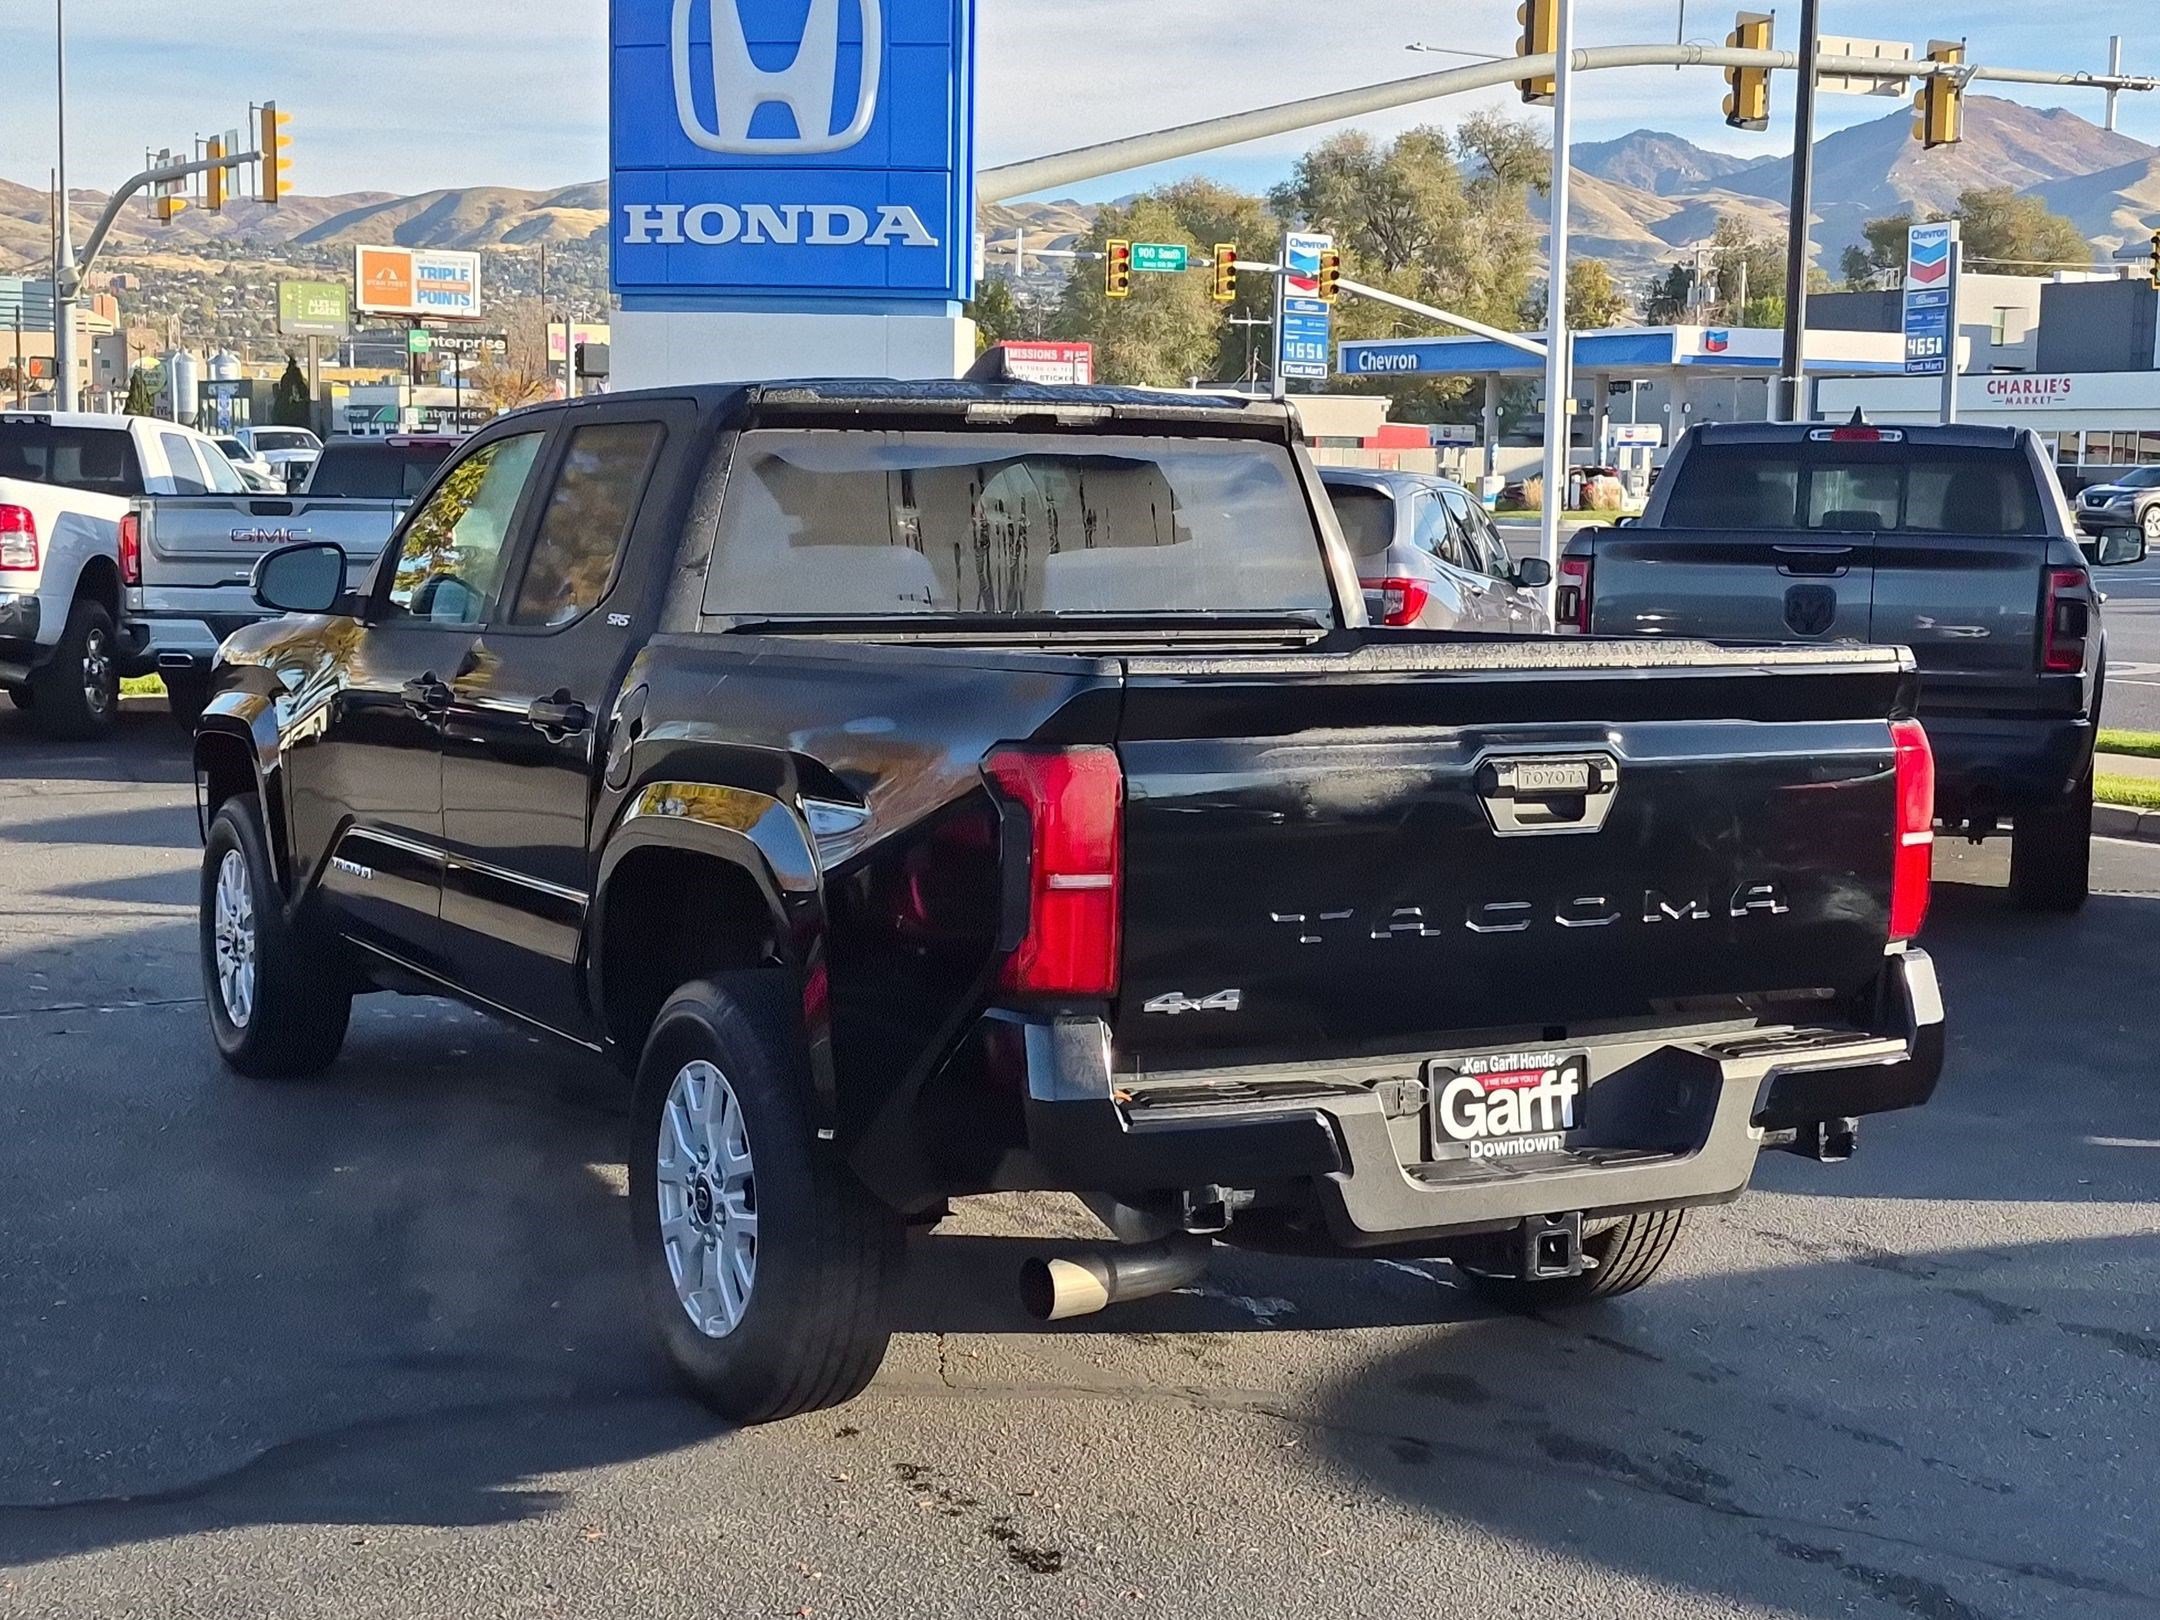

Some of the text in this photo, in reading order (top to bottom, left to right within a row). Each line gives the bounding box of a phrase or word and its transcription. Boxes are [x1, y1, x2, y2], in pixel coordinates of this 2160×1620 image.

[623, 203, 939, 247] HONDA
[1911, 229, 1948, 240] Chevron
[1290, 238, 1328, 249] Chevron
[1138, 247, 1155, 258] 900
[417, 266, 469, 281] TRIPLE
[417, 291, 470, 306] POINTS
[308, 306, 341, 316] LAGERS
[411, 335, 506, 352] enterprise
[1009, 348, 1057, 361] MISSIONS
[1359, 350, 1417, 371] Chevron
[1286, 364, 1323, 375] Food Mart
[1987, 378, 2071, 394] CHARLIE'S
[2005, 396, 2051, 405] MARKET
[230, 528, 312, 543] GMC
[607, 613, 631, 627] SR5
[1523, 770, 1586, 785] TOYOTA
[1271, 881, 1789, 943] TACOMA
[1465, 1052, 1555, 1074] Ken Garff Honda
[1440, 1068, 1578, 1140] Garff
[1471, 1136, 1559, 1158] Downtown
